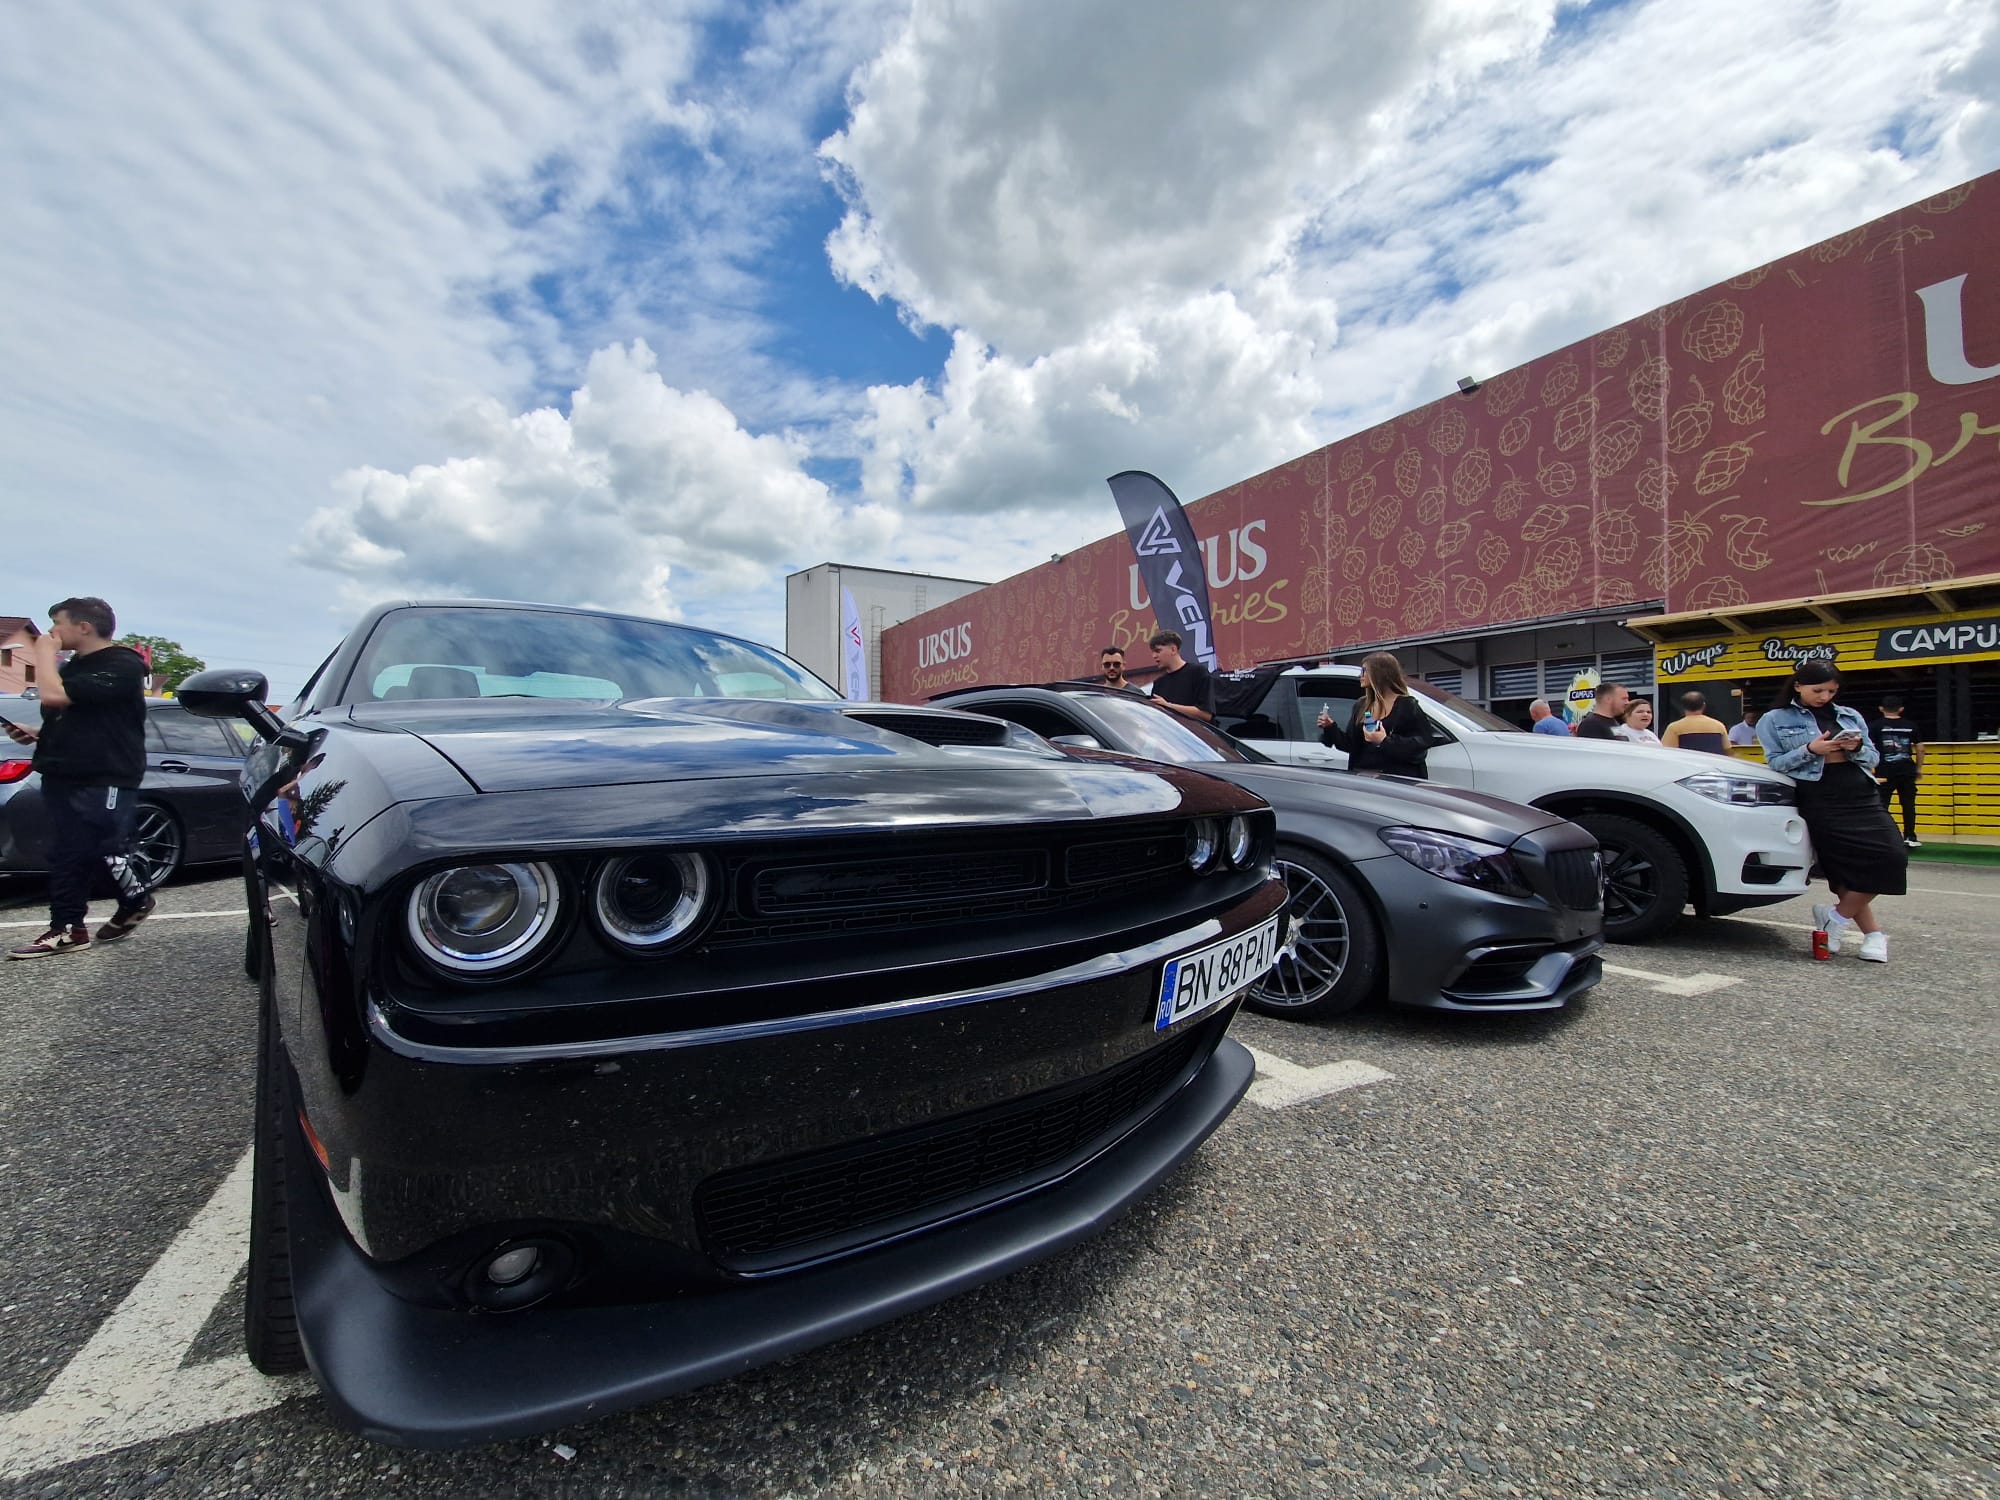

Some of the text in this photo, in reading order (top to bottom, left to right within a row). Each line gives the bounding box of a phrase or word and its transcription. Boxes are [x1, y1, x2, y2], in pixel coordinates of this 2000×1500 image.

[1129, 519, 1268, 610] UUS
[918, 621, 972, 668] URSUS
[1890, 623, 2000, 652] CAMPU
[1662, 643, 1725, 675] Wraps
[1763, 638, 1836, 671] Burgers
[910, 658, 979, 696] Breweries
[1571, 690, 1594, 699] CAMPUS
[1175, 955, 1214, 1013] BN
[1160, 999, 1172, 1019] RO
